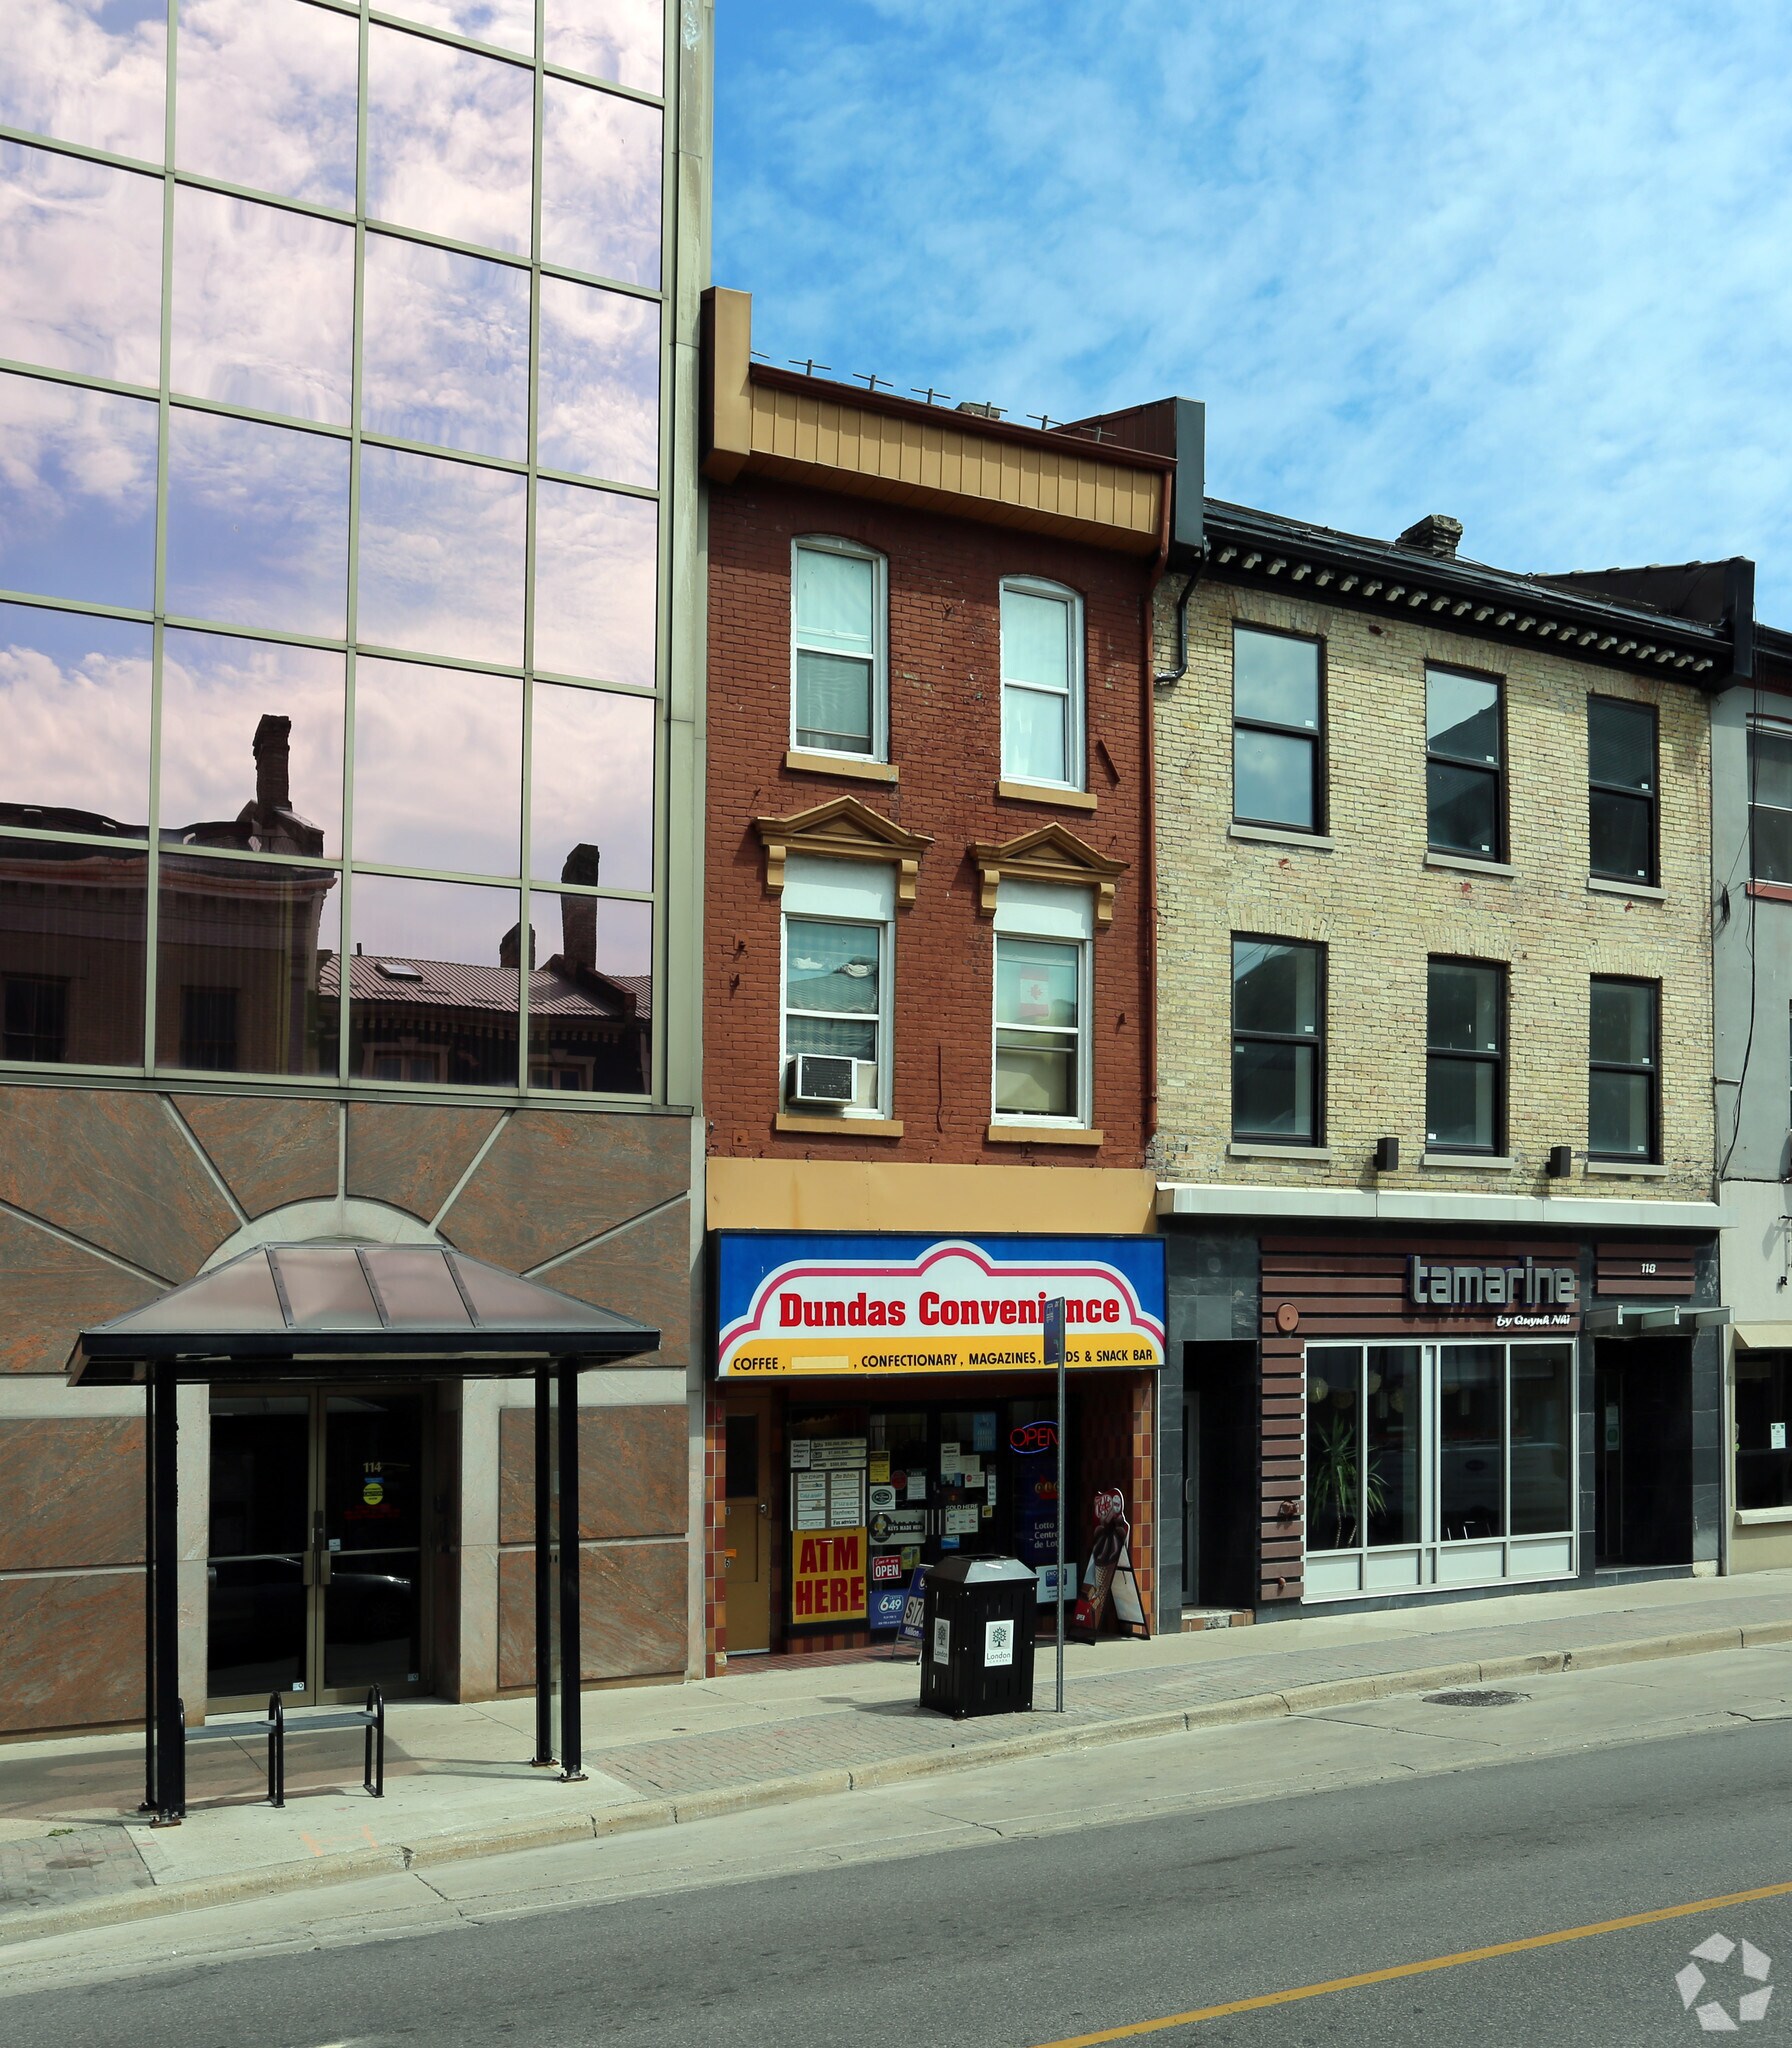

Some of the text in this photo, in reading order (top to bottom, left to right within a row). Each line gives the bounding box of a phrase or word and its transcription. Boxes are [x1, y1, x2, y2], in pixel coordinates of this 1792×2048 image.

[1641, 1263, 1656, 1274] 118
[1409, 1255, 1576, 1304] tamarine
[779, 1292, 906, 1327] Dundas
[919, 1291, 1120, 1325] Convenince
[1496, 1314, 1571, 1327] by Quynh Nhi
[1084, 1350, 1092, 1362] &
[1096, 1349, 1128, 1362] SNACK
[1133, 1348, 1153, 1361] BAR
[1009, 1427, 1059, 1447] OPEN
[363, 1461, 382, 1473] 114
[1034, 1522, 1055, 1530] Lotto
[1034, 1541, 1044, 1549] de
[800, 1535, 858, 1574] ATM
[875, 1564, 899, 1577] OPEN
[795, 1576, 865, 1616] HERE
[986, 1651, 1011, 1660] London
